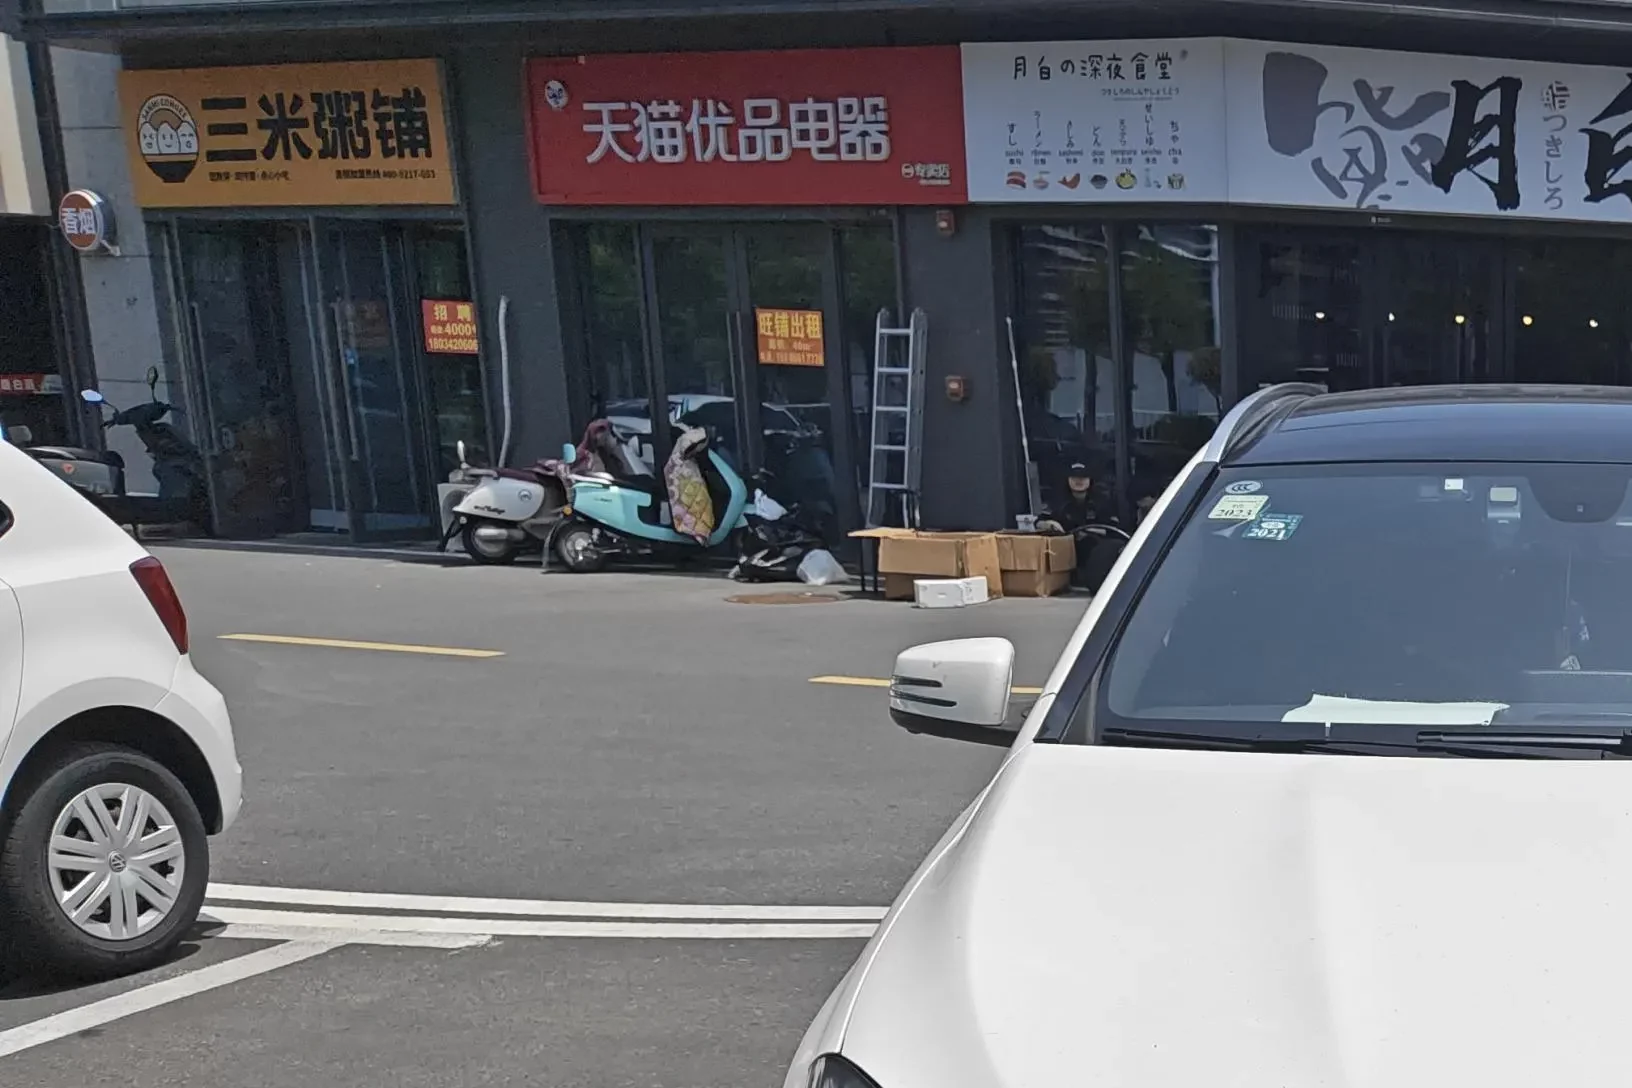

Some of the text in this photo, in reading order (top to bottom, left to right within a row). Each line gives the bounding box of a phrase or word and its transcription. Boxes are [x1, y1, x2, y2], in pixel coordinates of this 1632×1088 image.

[1013, 52, 1173, 80] 月白の深夜食堂
[201, 86, 433, 162] 三米粥铺
[582, 96, 891, 164] 天猫优品电器
[1542, 114, 1568, 211] つきしろ
[61, 207, 95, 235] 香烟
[758, 311, 822, 338] 旺铺出租
[1247, 528, 1287, 541] 2021
